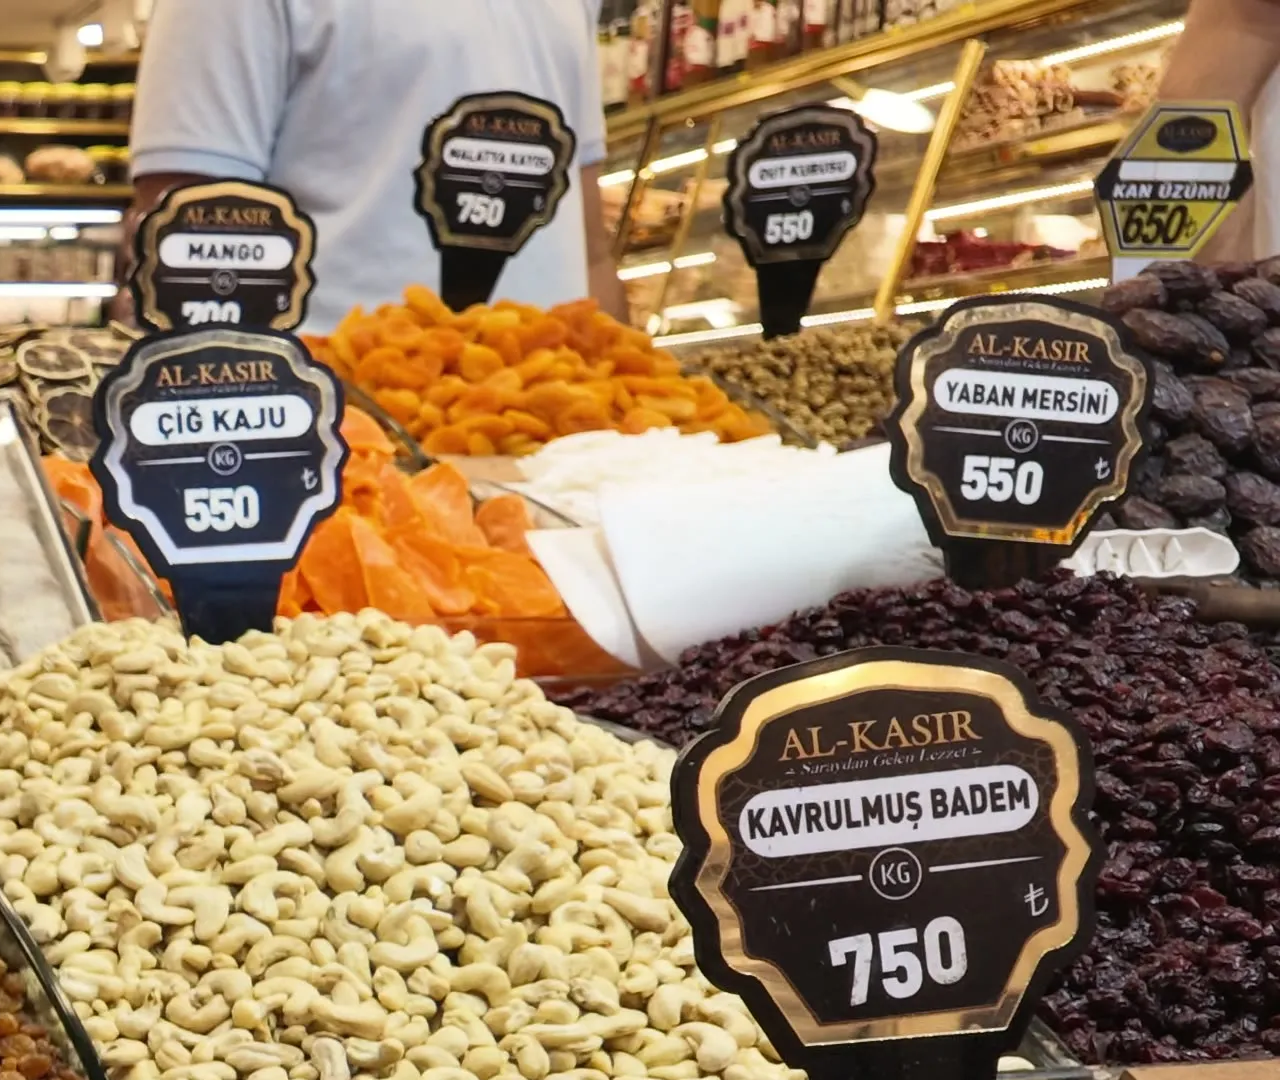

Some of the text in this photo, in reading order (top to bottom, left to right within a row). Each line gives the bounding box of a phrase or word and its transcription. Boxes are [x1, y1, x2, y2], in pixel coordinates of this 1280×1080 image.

[1113, 183, 1153, 199] KAN
[184, 207, 273, 226] AL-KASIR
[456, 192, 506, 228] 750
[765, 210, 814, 244] 550
[188, 243, 265, 261] MANGO
[968, 333, 1092, 363] AL-KASIR
[156, 360, 278, 388] AL-KASIR
[947, 381, 1109, 416] YABAN MERSİNİ
[157, 403, 286, 440] ÇİĞ KAJU
[1011, 428, 1032, 445] KG
[215, 450, 235, 467] KG
[960, 455, 1044, 505] 550
[183, 484, 260, 533] 550
[778, 710, 983, 762] AL-KASIR
[801, 747, 968, 776] Saraydan Gelen Lezzet
[747, 779, 1031, 840] KAVRULMUŞ BADEM
[880, 862, 911, 886] KG
[828, 915, 968, 1008] 750
